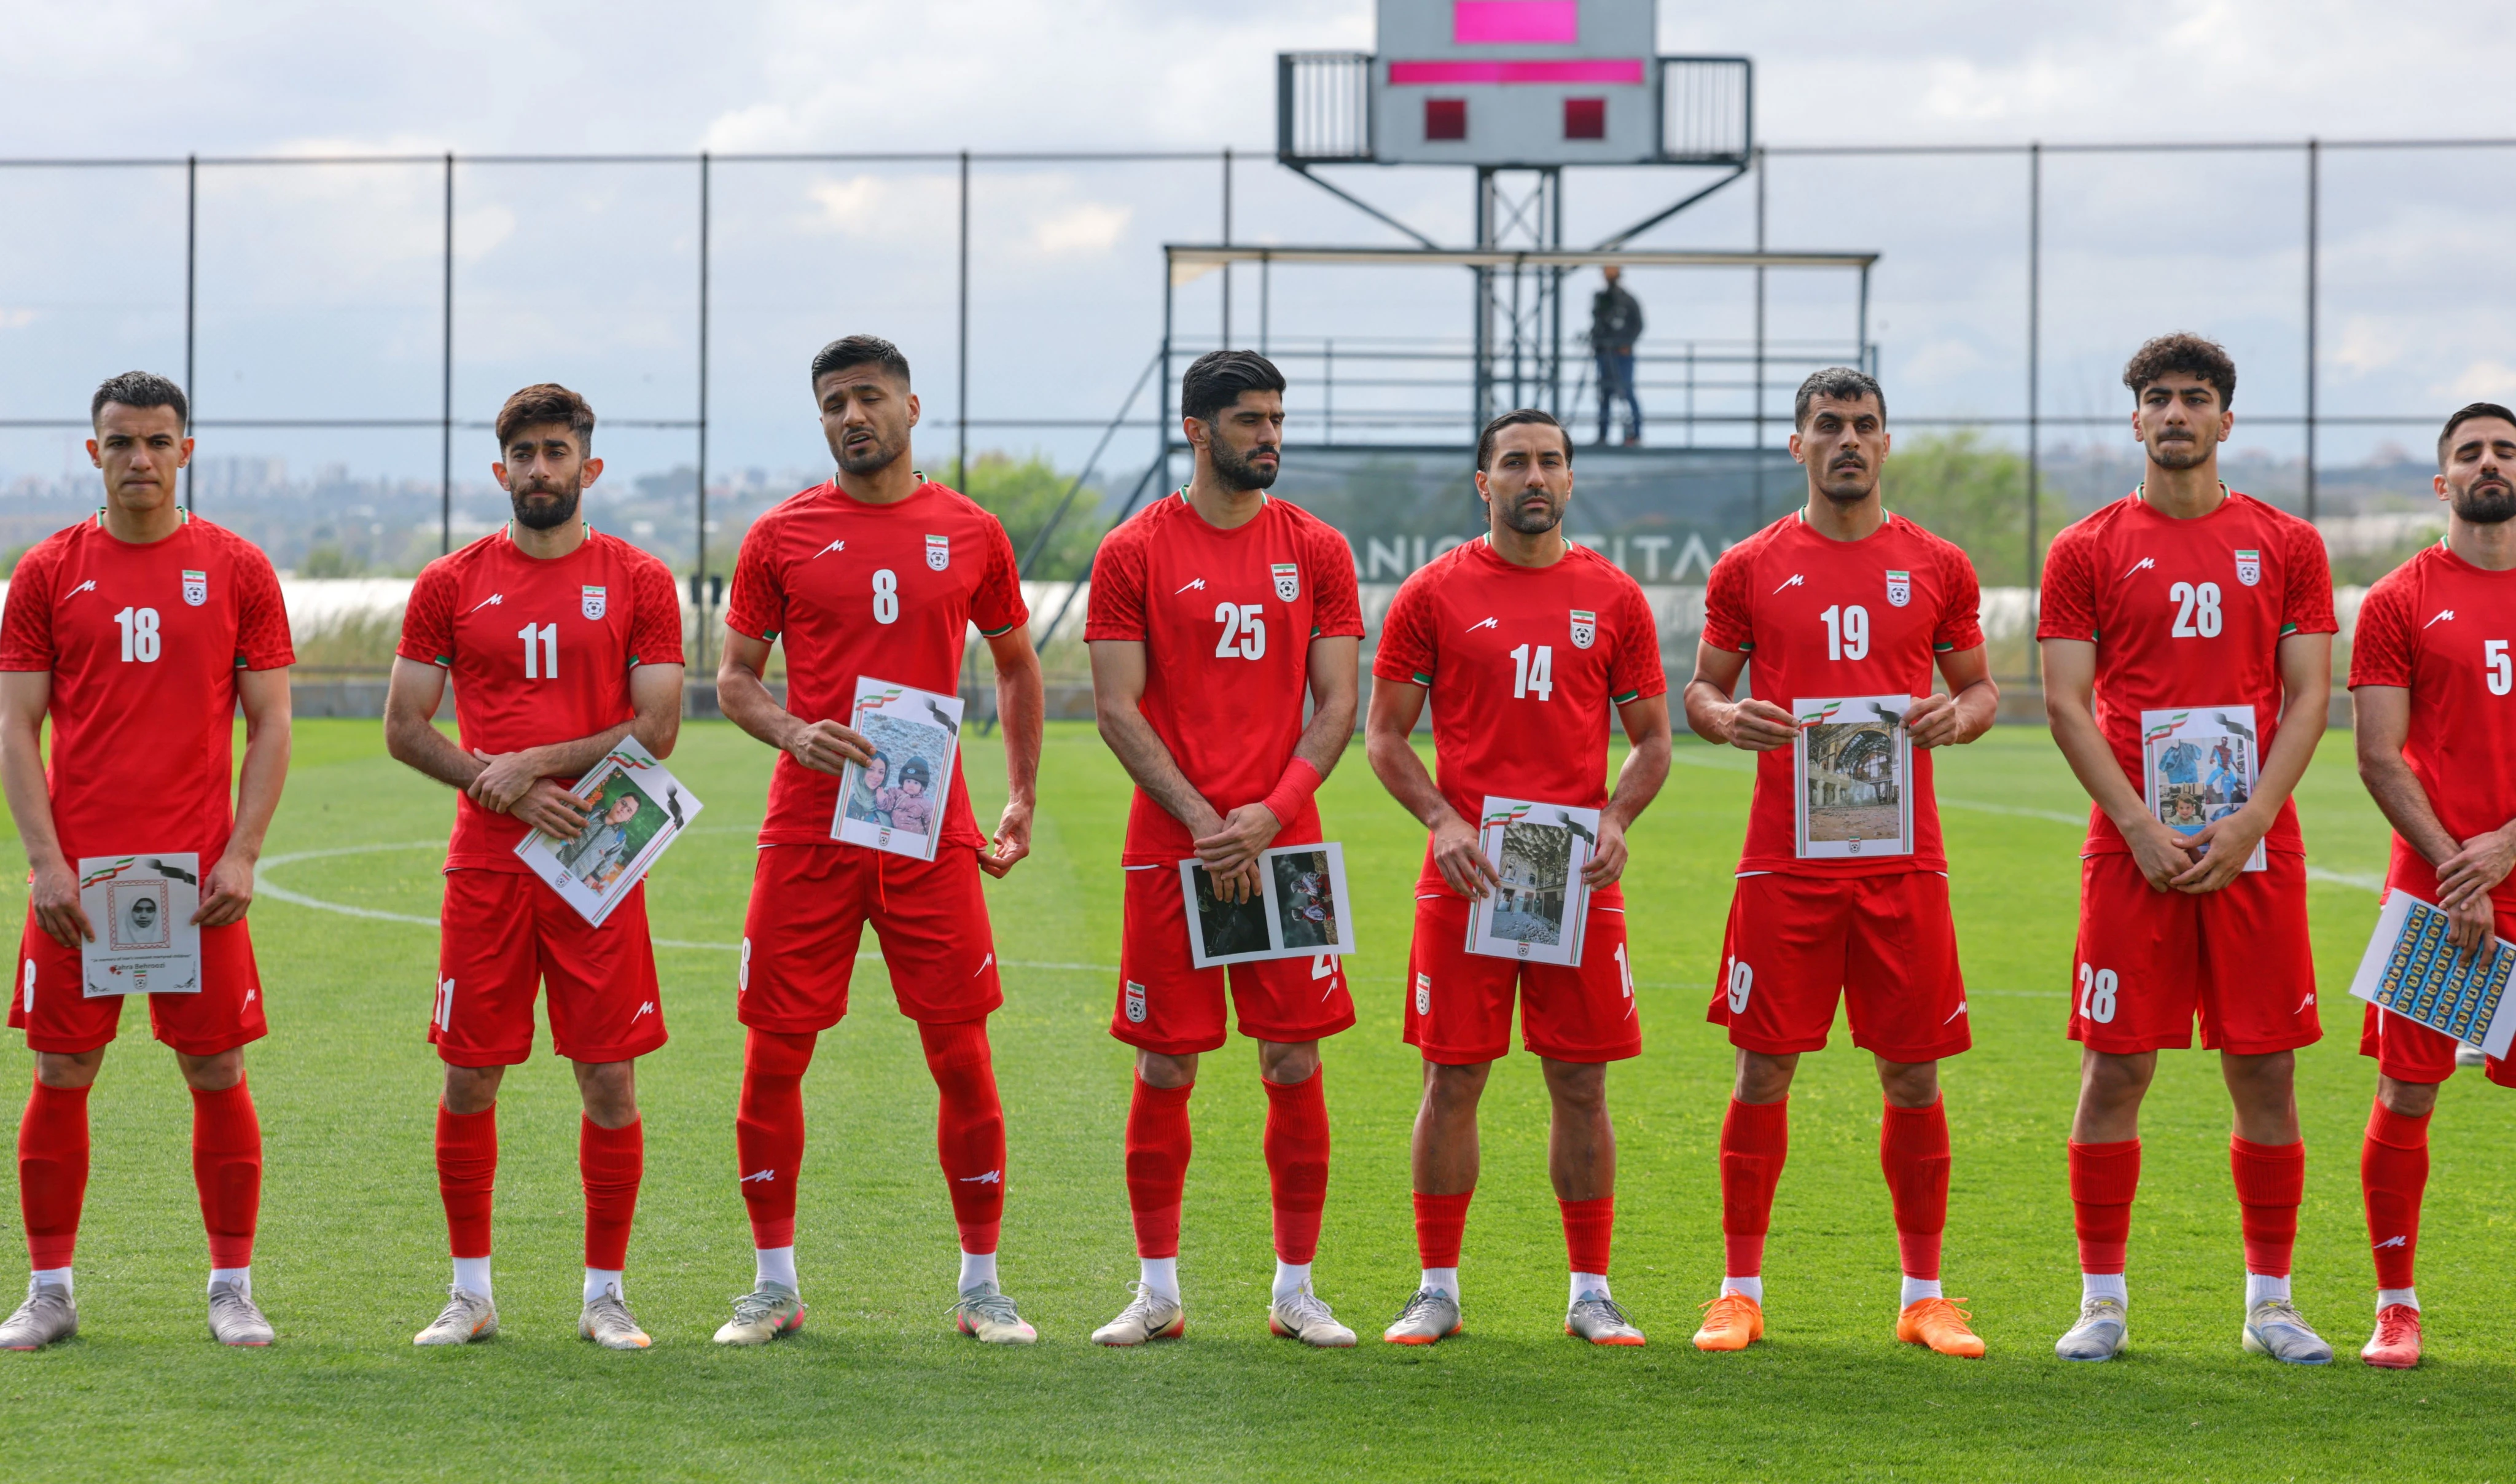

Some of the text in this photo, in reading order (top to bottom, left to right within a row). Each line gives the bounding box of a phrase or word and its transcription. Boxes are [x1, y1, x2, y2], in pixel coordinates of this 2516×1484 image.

[872, 569, 899, 625] 8
[2170, 581, 2222, 638] 28
[114, 606, 161, 663] 18
[518, 622, 558, 679] 11
[1214, 601, 1265, 660] 25
[1820, 604, 1869, 661] 19
[1510, 643, 1553, 701] 14
[2484, 639, 2512, 696] 5
[1614, 942, 1633, 998] 1
[2079, 962, 2119, 1023] 28
